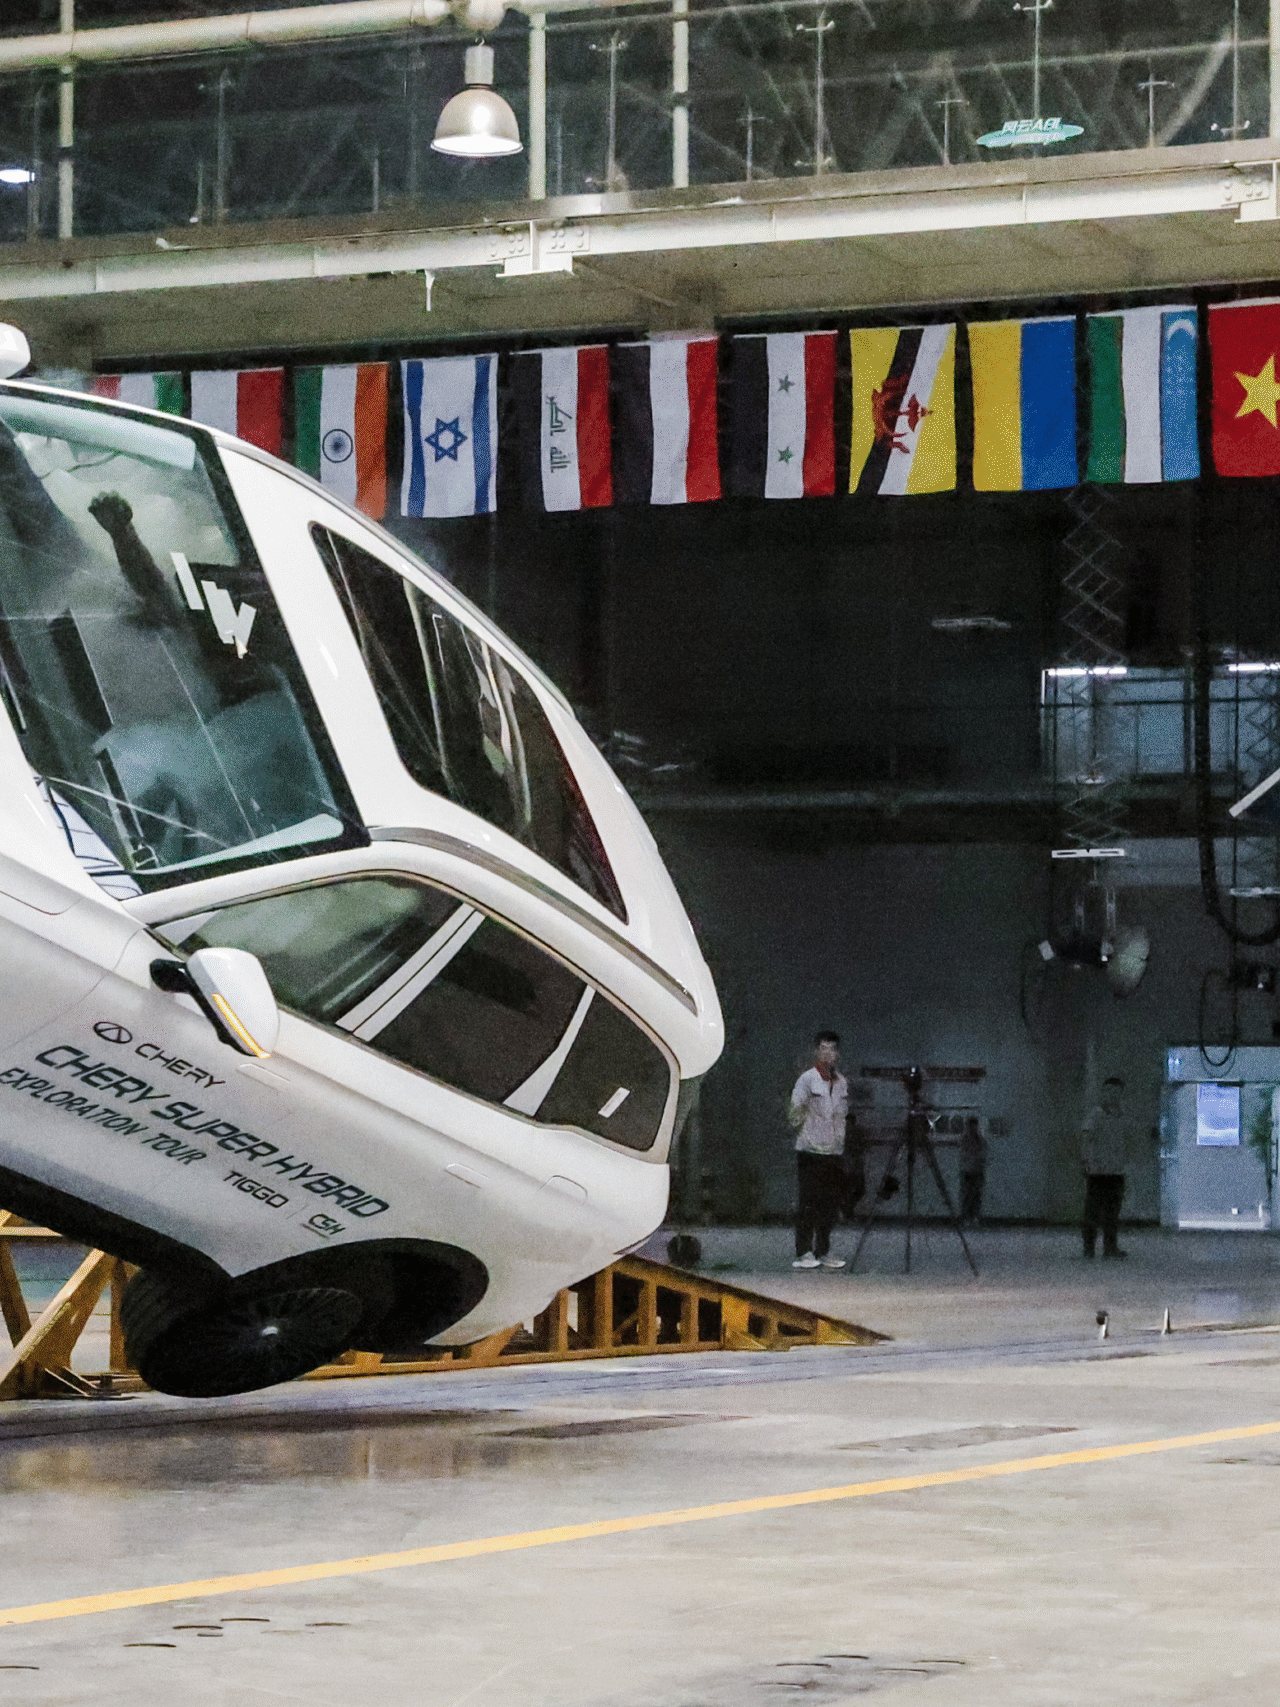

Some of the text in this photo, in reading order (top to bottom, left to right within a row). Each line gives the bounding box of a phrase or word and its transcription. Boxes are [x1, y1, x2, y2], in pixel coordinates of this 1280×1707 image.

[135, 1043, 225, 1089] CHERY
[36, 1045, 389, 1218] CHERY SUPER HYBRID
[142, 1132, 208, 1165] TOUR
[223, 1170, 346, 1235] TIGGO CSH
